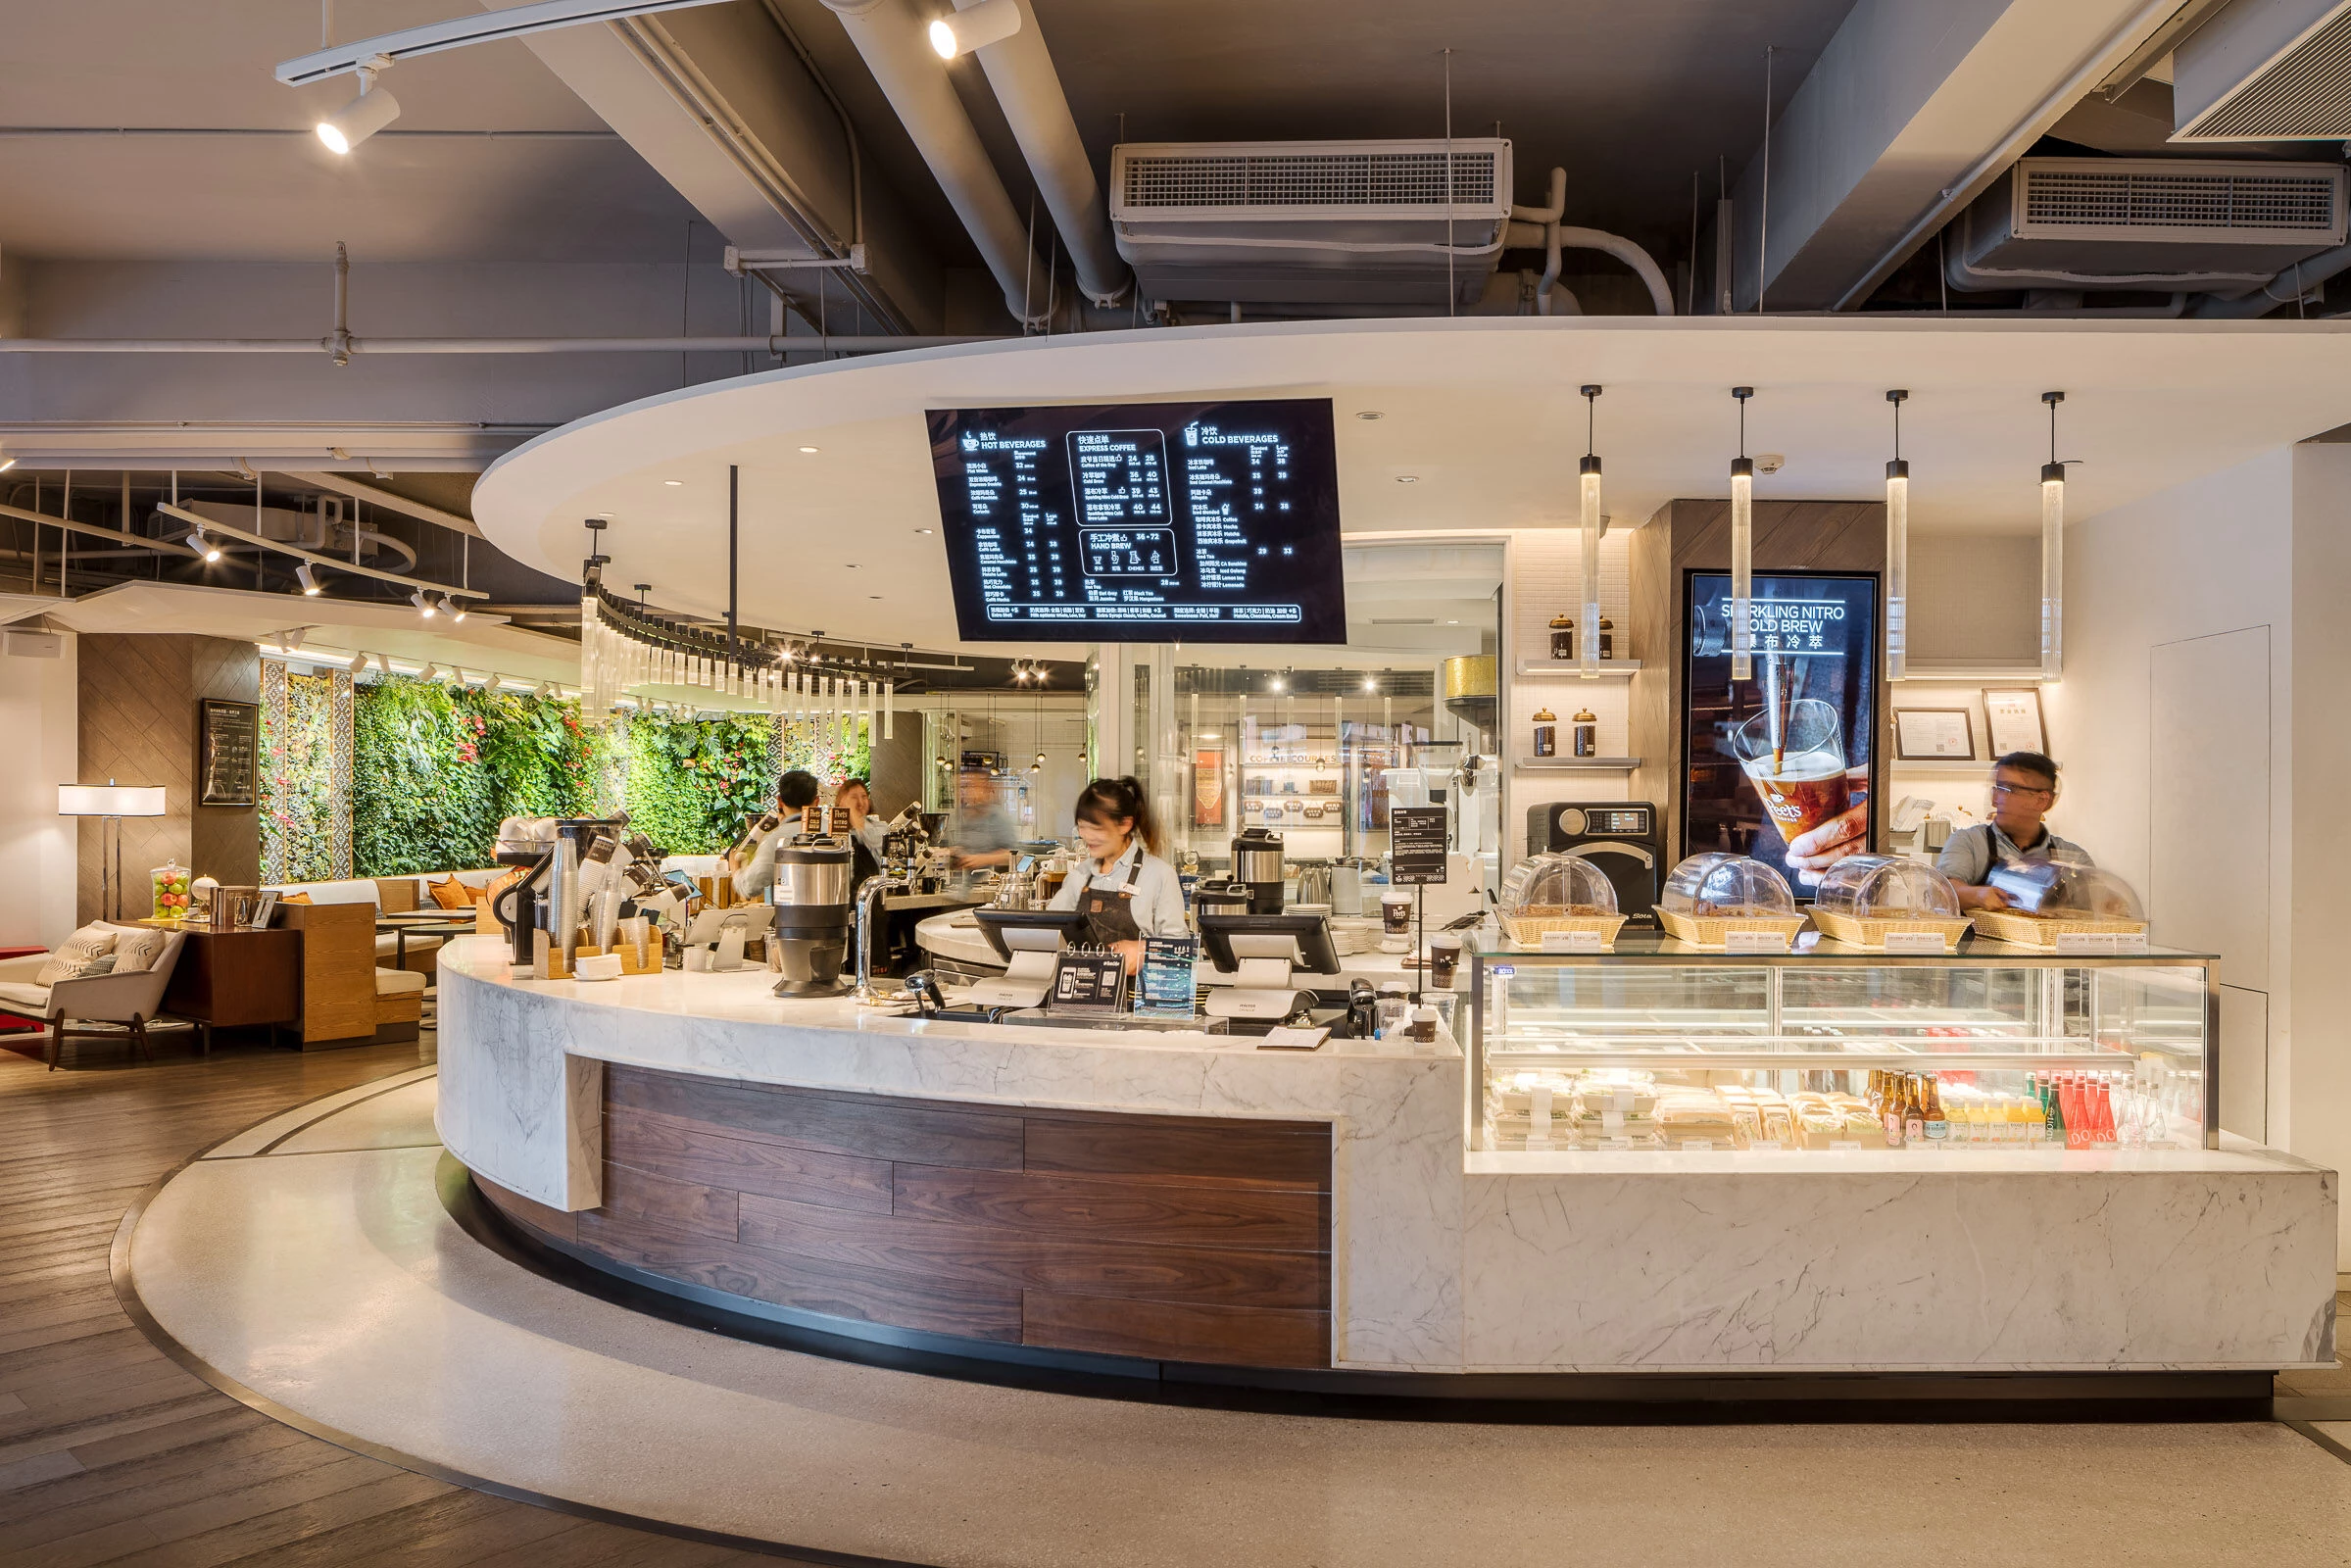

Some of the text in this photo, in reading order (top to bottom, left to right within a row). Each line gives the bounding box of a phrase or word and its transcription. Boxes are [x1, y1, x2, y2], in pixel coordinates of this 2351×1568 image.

[1078, 434, 1109, 445] 快速点单
[1227, 434, 1279, 444] BEVERAGES
[981, 440, 1047, 450] HOT BEVERAGES
[1722, 604, 1844, 619] SRKLING NITRO
[1745, 618, 1823, 633] OLD BREW
